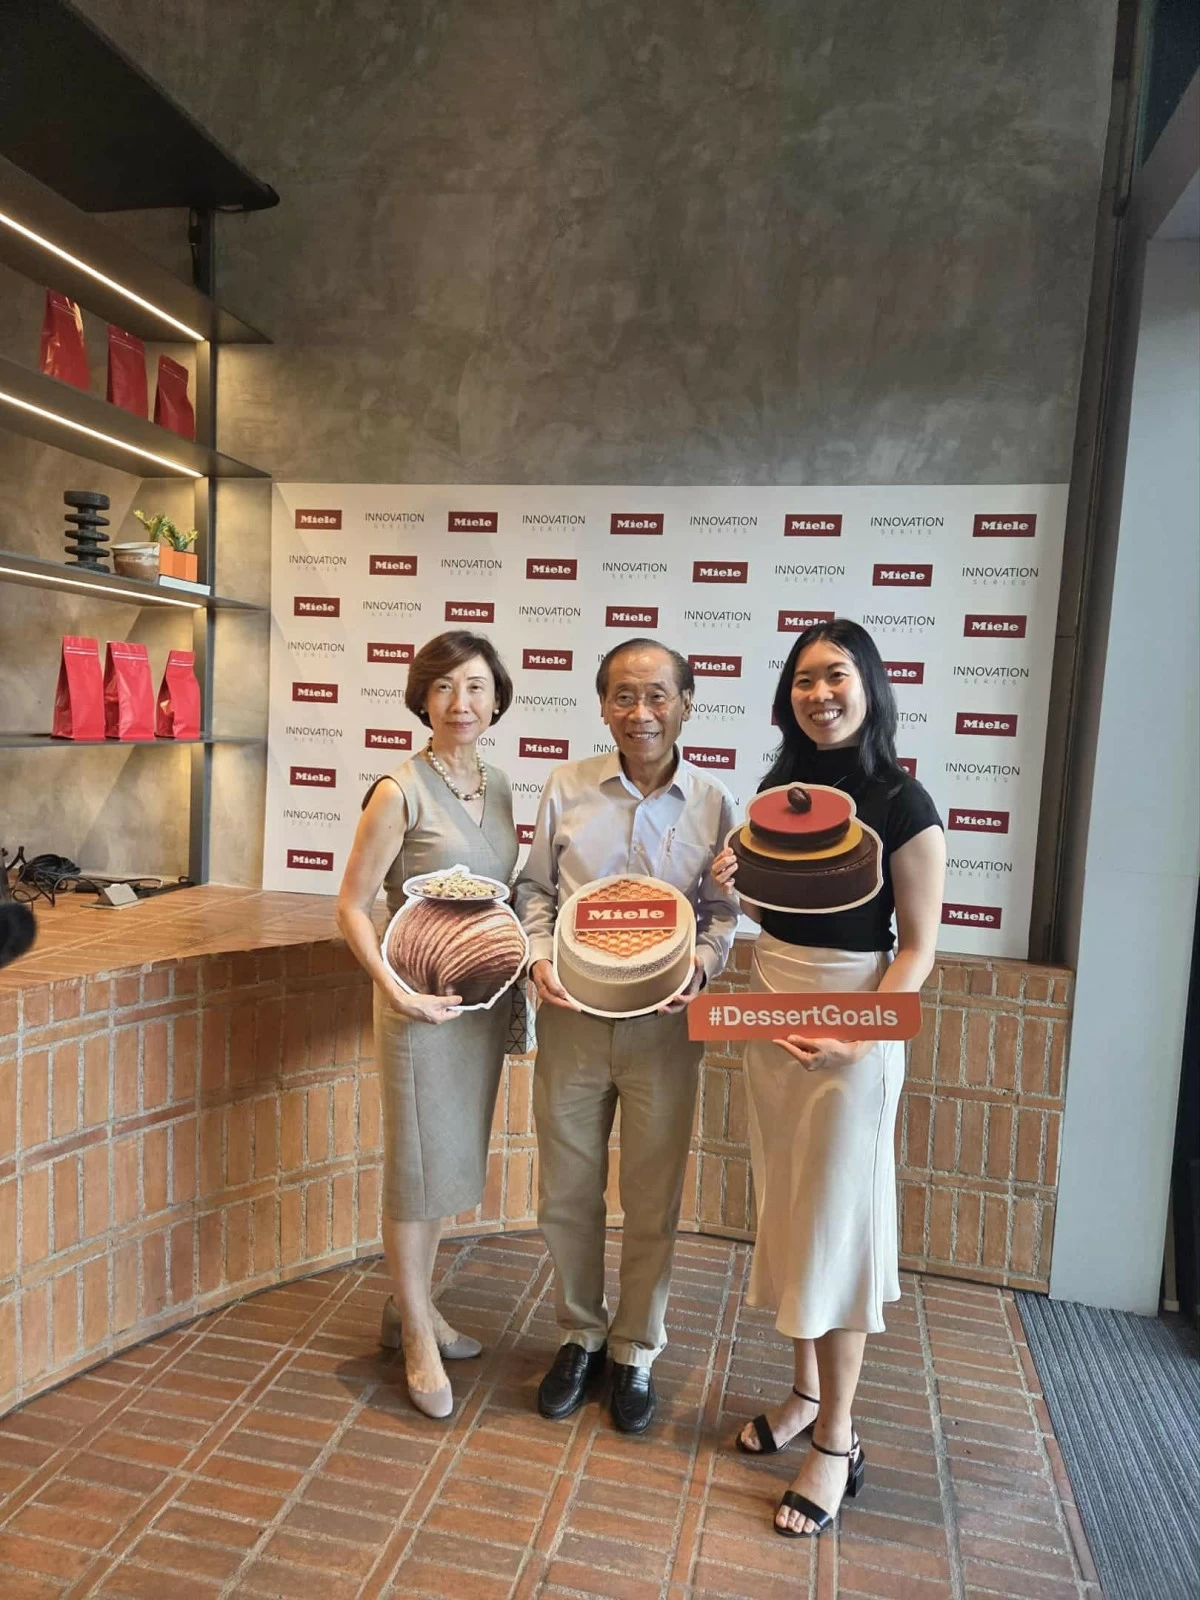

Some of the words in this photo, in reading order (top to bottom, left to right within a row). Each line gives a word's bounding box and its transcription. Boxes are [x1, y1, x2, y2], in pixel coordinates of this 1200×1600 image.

[300, 515, 337, 524] Miele
[365, 513, 424, 522] INNOVATION
[454, 518, 492, 527] Miele
[522, 515, 586, 524] INNOVATION
[690, 516, 758, 526] INNOVATION
[870, 516, 944, 527] INNOVATION
[617, 520, 657, 529] Miele
[791, 521, 835, 530] Miele
[981, 521, 1029, 531] Miele
[289, 555, 346, 565] INNOVATION
[441, 559, 502, 569] INNOVATION
[375, 561, 412, 570] Miele
[532, 565, 571, 574] Miele
[602, 562, 667, 572] INNOVATION
[775, 565, 845, 576] INNOVATION
[700, 568, 741, 578] Miele
[880, 570, 926, 580] Miele
[962, 567, 1039, 578] INNOVATION
[299, 603, 335, 612] Miele
[362, 601, 422, 611] INNOVATION
[519, 606, 581, 616] INNOVATION
[451, 608, 489, 617] Miele
[612, 613, 652, 622] Miele
[684, 611, 751, 621] INNOVATION
[862, 615, 935, 626] INNOVATION
[971, 621, 1019, 632] Miele
[287, 642, 345, 652] INNOVATION
[373, 649, 409, 658] Miele
[528, 655, 567, 665] Miele
[694, 662, 735, 671] Miele
[953, 666, 1029, 677] INNOVATION
[886, 668, 917, 678] iele
[297, 688, 333, 698] Miele
[361, 688, 404, 697] INNOVATI
[515, 696, 577, 706] INNOVATION
[691, 703, 745, 714] NOVATION
[963, 719, 1010, 730] Miele
[286, 726, 343, 737] INNOVATION
[370, 735, 407, 744] Miele
[525, 744, 563, 753] Miele
[688, 753, 729, 763] Miele
[945, 763, 1020, 775] INNOVATION
[295, 772, 331, 782] Miele
[511, 783, 544, 793] INNOV
[283, 810, 341, 821] INNOVATION
[956, 815, 1002, 826] Miele
[292, 856, 328, 865] Miele
[945, 859, 1013, 872] NNOVATION
[587, 908, 665, 921] Miele
[948, 909, 995, 922] Miele
[709, 1005, 898, 1026] #DessertGoals
